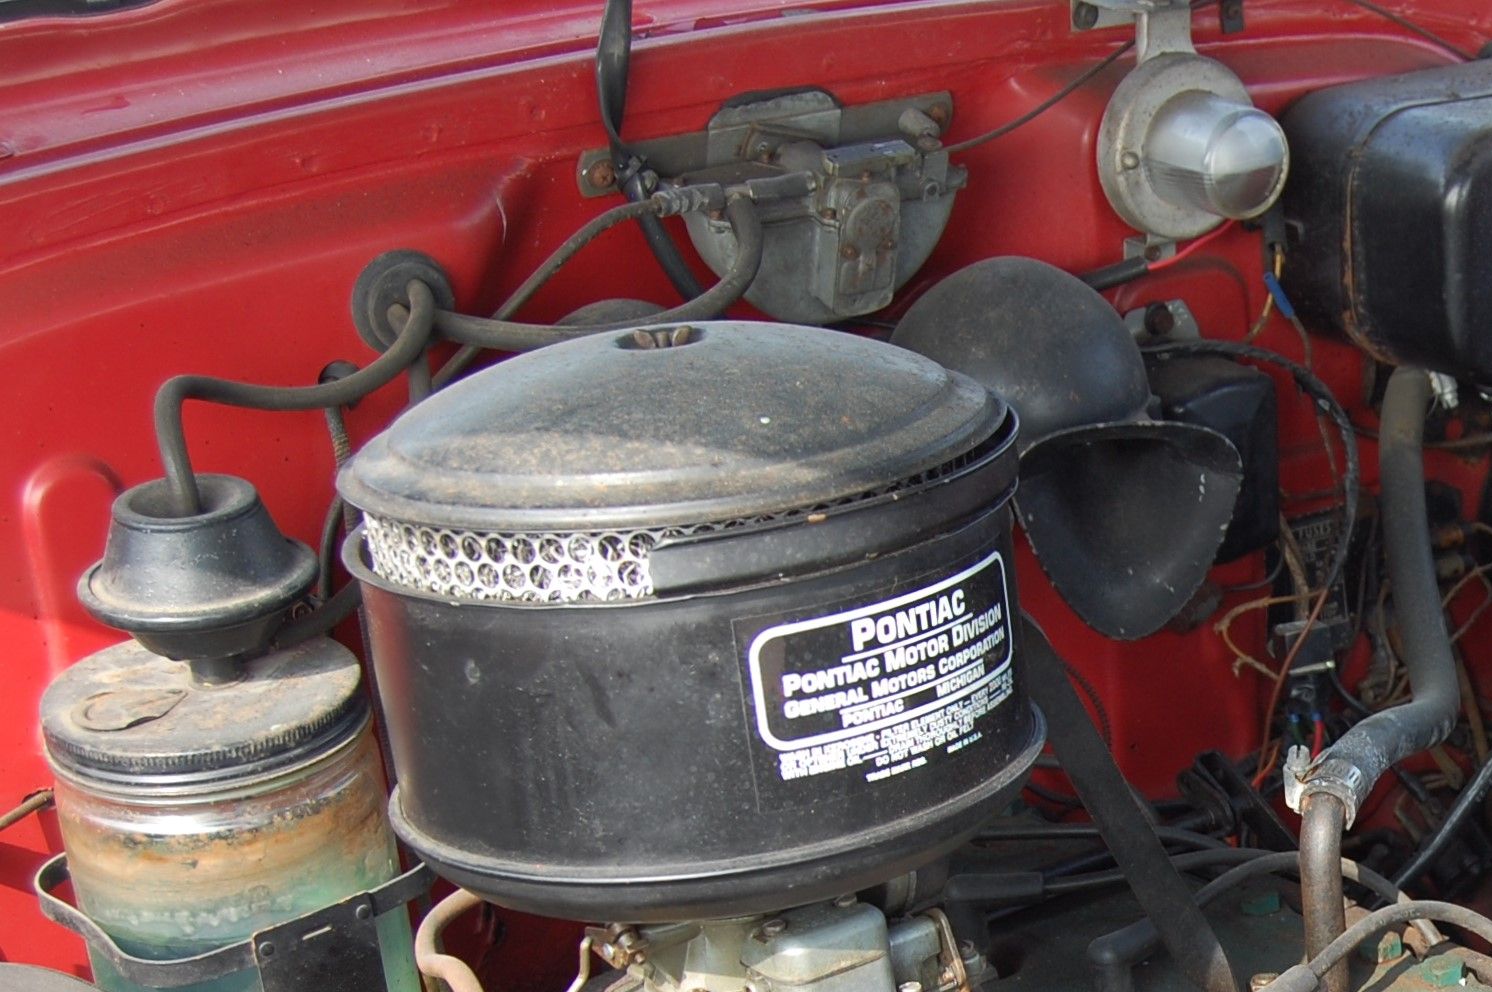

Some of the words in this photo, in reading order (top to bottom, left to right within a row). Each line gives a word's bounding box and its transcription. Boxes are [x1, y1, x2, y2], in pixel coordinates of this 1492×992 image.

[782, 658, 880, 698] PONTIAC
[884, 634, 950, 673] MOTOR
[952, 603, 1002, 647] DIVISION
[851, 588, 967, 652] PONTIAC
[783, 690, 869, 720] GENERAL
[871, 664, 936, 699] MOTORS
[938, 626, 1005, 676] CORPORATION
[841, 699, 905, 729] PONTIAC
[936, 662, 986, 698] MICHIGAN
